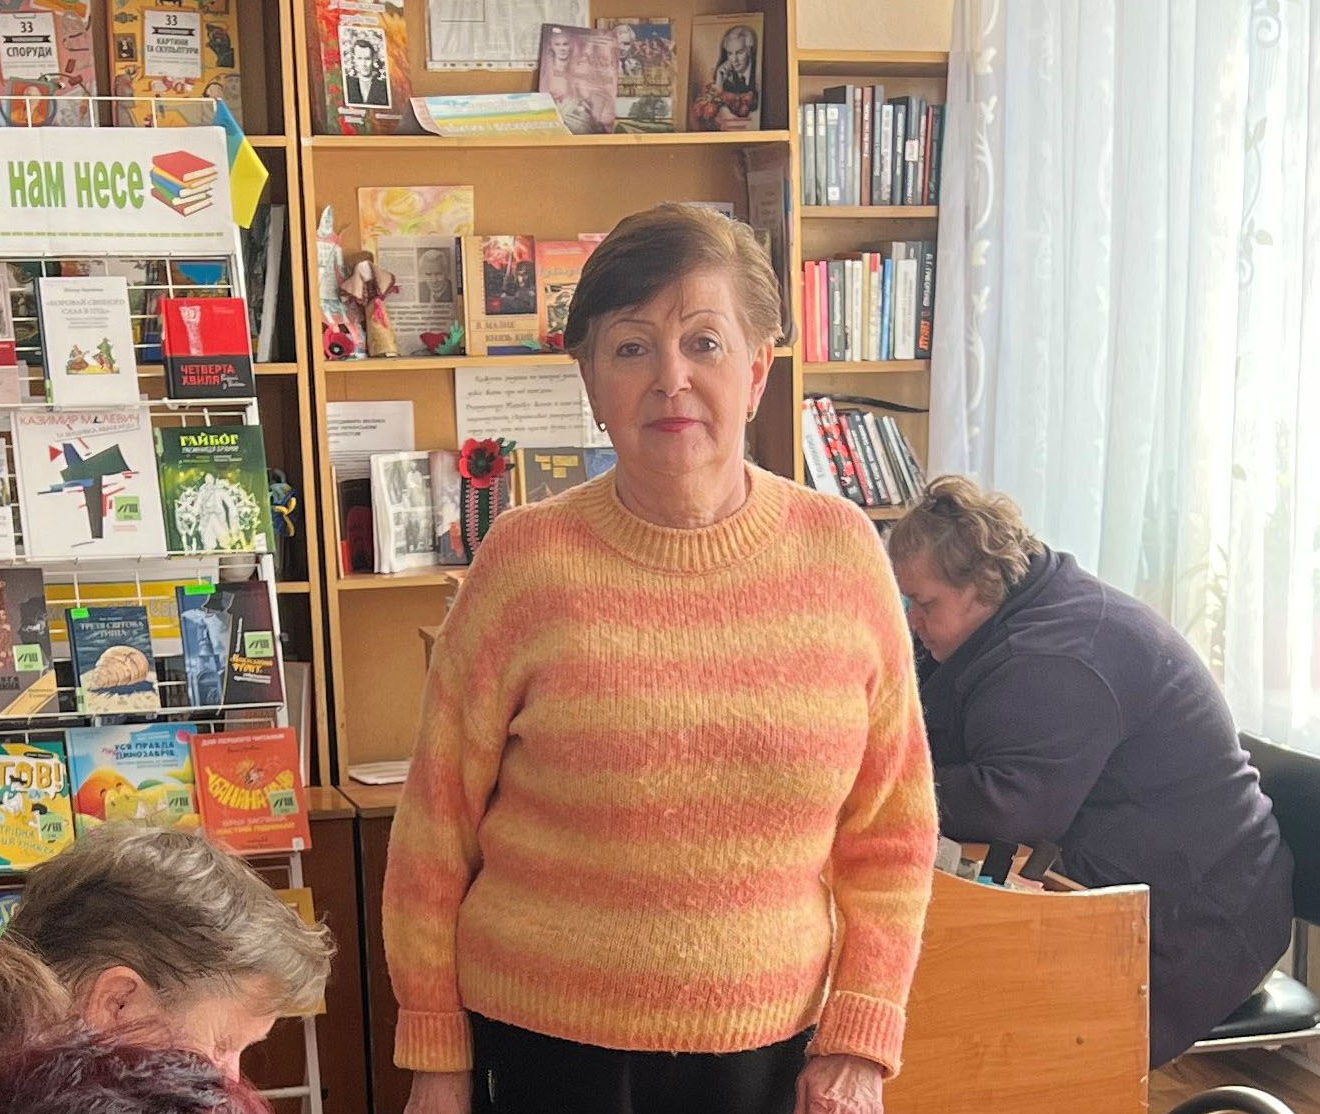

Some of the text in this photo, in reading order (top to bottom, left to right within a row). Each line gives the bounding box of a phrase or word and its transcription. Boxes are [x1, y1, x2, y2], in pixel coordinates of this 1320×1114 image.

[165, 15, 178, 26] 33
[20, 21, 33, 33] 33
[6, 46, 53, 58] СПОРУДИ
[7, 158, 66, 209] нам
[77, 159, 145, 209] несе
[180, 364, 235, 375] ЧЕТВЕРТА
